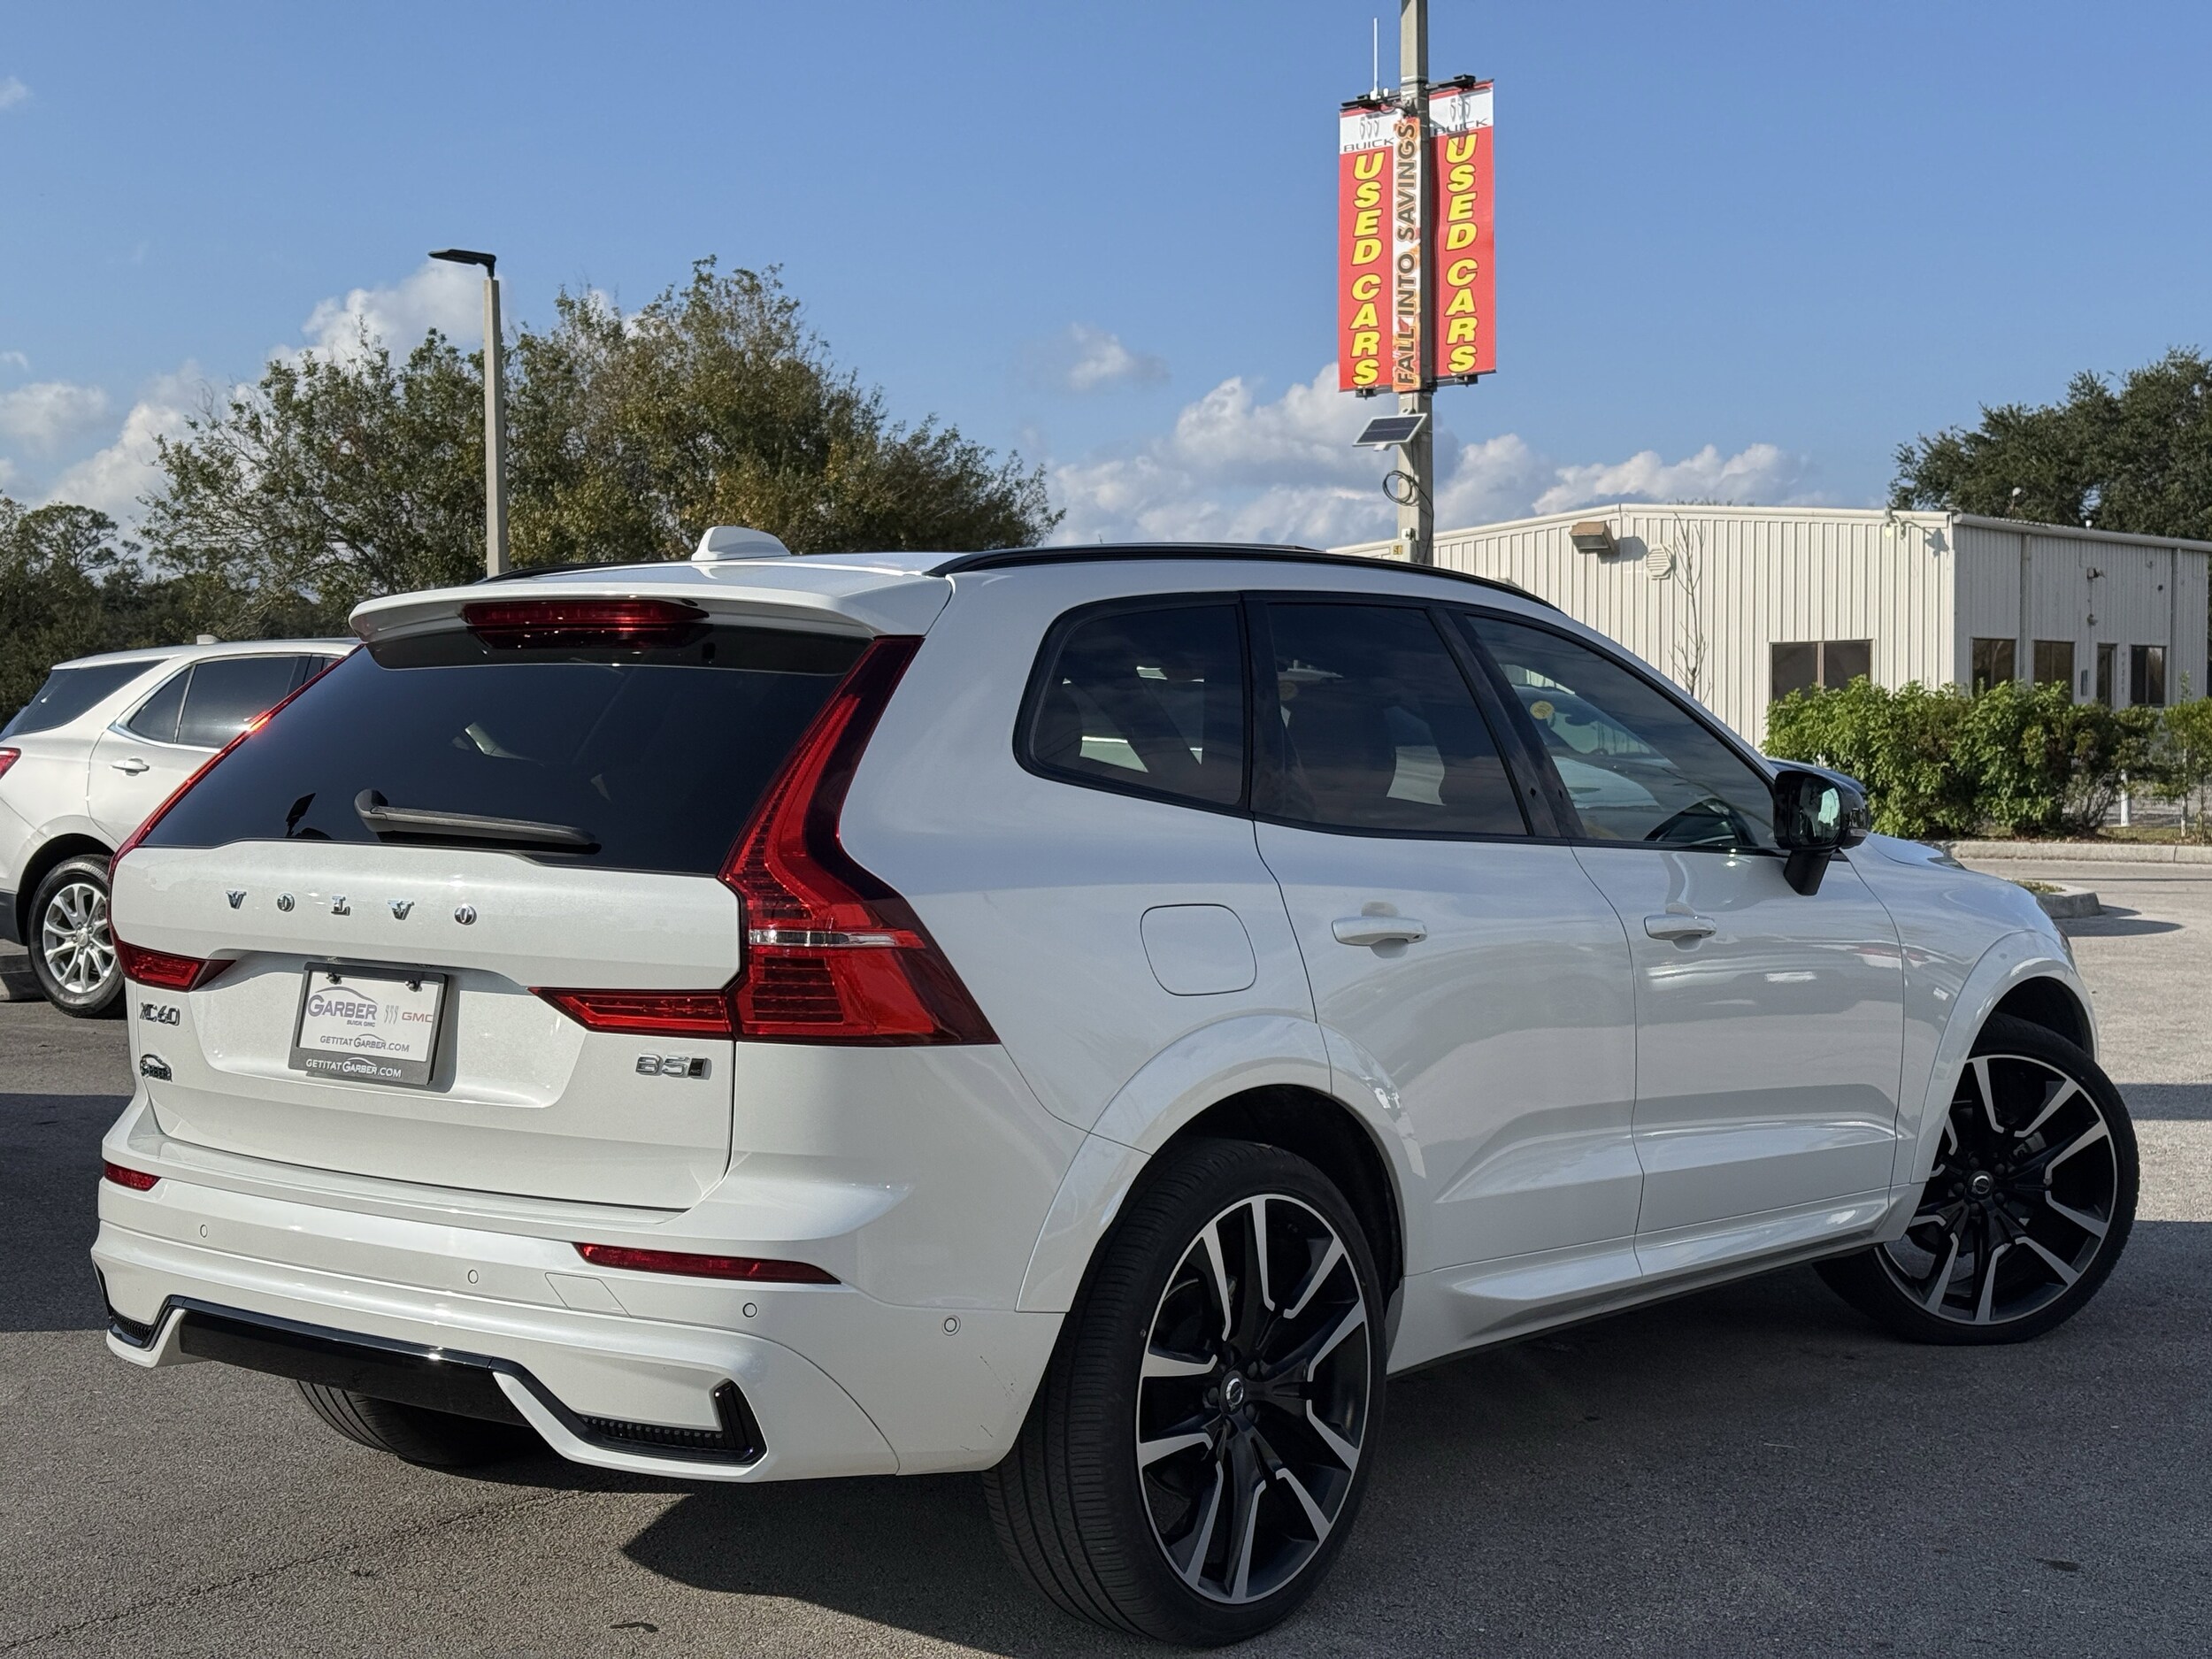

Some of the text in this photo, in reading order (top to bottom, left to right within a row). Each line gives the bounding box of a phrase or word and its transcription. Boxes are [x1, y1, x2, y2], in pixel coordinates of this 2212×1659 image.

[1434, 118, 1488, 135] BUICK
[1343, 137, 1394, 152] BUICK
[1397, 123, 1416, 385] FALL INTO SAVINGS
[1444, 133, 1479, 373] USED CARS
[1348, 151, 1386, 386] USED CARS
[225, 888, 478, 926] VOLVO
[139, 1002, 180, 1026] XC60
[308, 995, 378, 1020] GARBER
[401, 1011, 434, 1023] GMC
